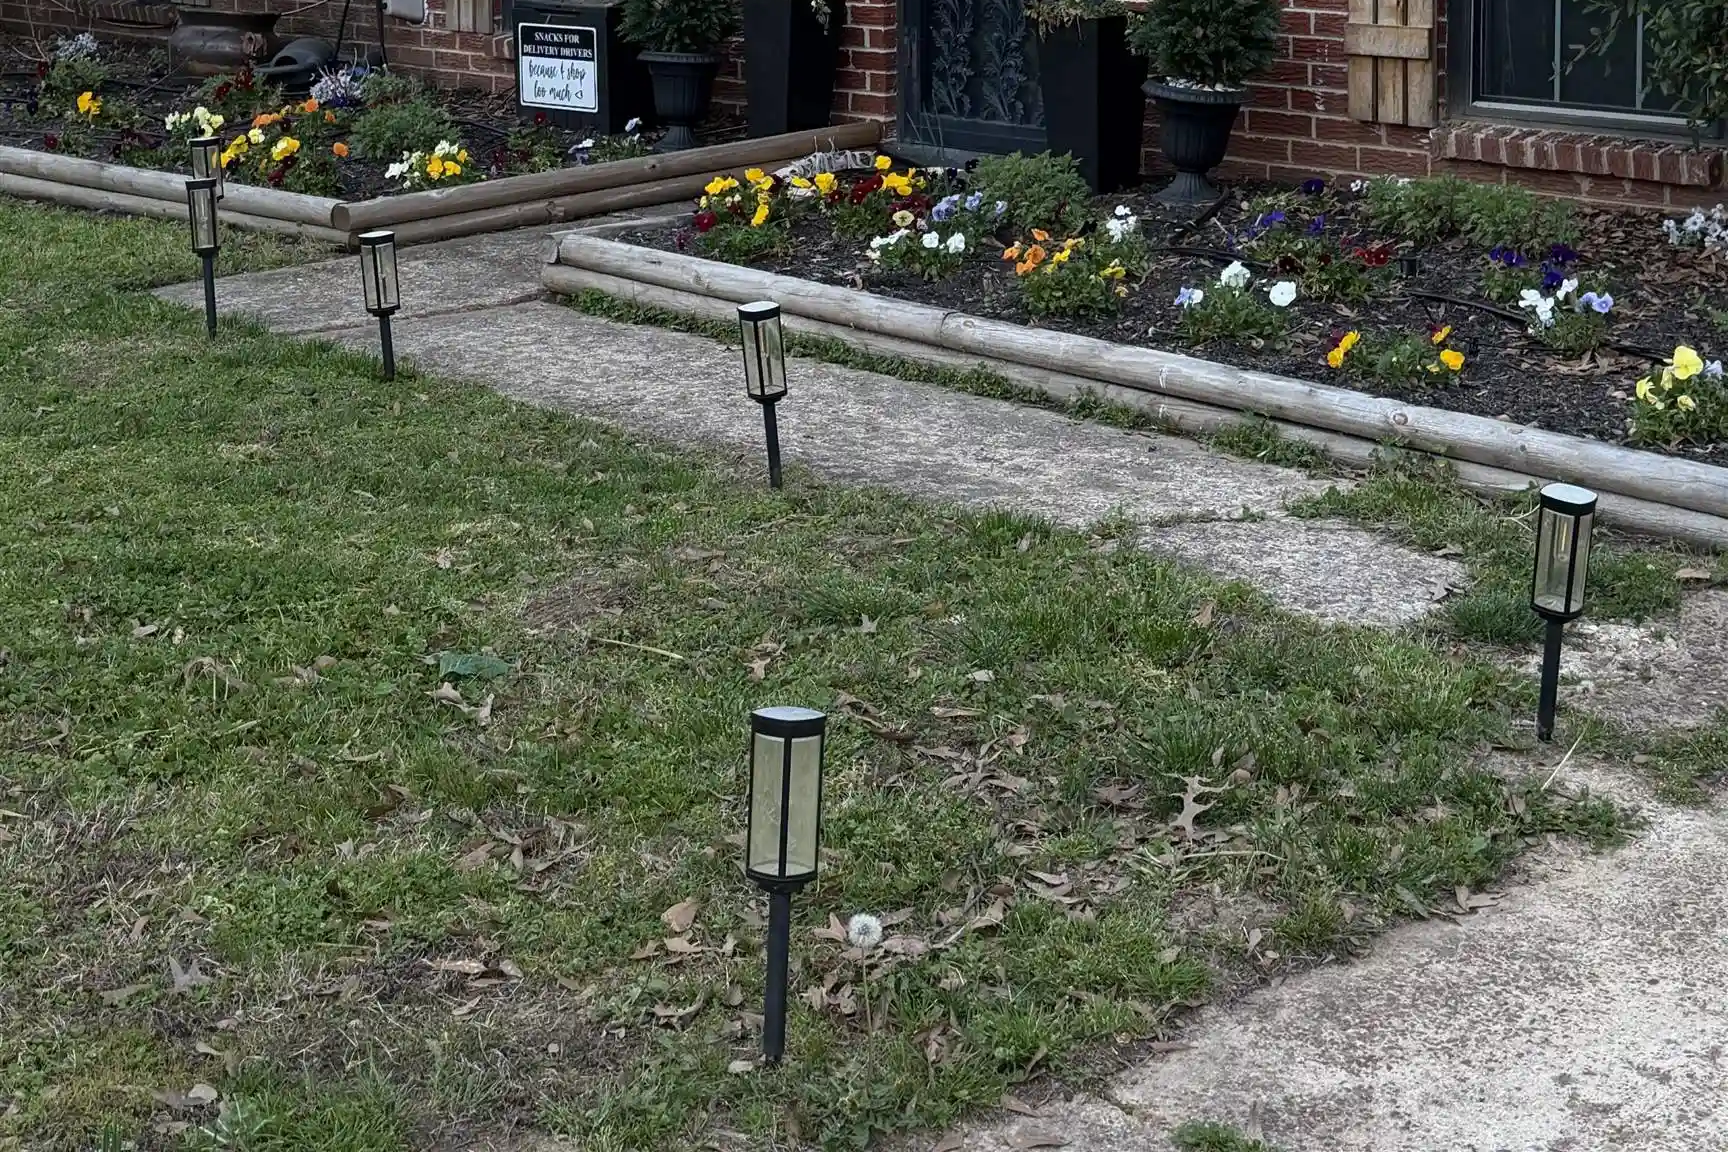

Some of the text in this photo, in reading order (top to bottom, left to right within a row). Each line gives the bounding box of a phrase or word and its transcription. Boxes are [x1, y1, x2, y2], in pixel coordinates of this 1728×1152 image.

[534, 31, 580, 44] SNACKS FOR
[523, 44, 593, 58] DELIVERY DRIVERS
[528, 59, 558, 78] because
[566, 62, 587, 86] shop
[534, 80, 572, 102] too much
